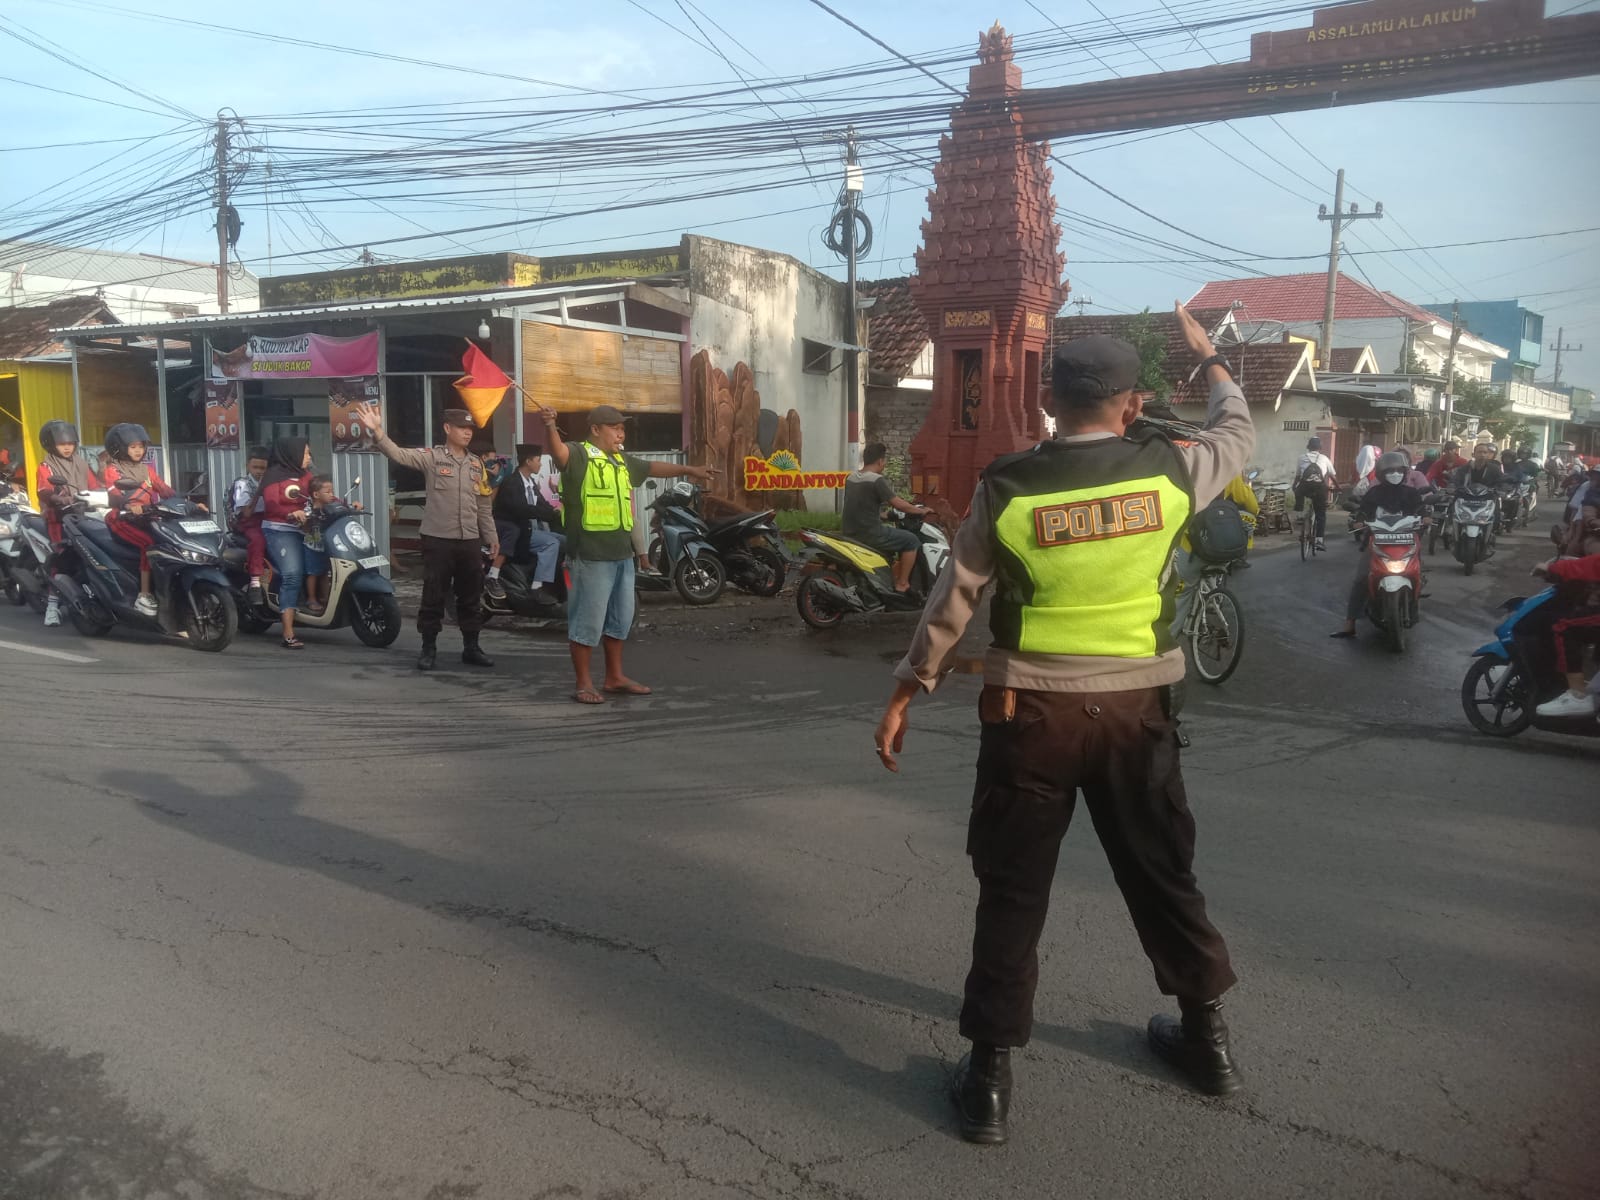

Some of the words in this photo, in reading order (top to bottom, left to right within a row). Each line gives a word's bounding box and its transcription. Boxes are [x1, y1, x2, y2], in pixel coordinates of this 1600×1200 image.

[1307, 18, 1394, 42] ASSALAMU
[1398, 7, 1477, 30] ALAIKUM
[284, 360, 312, 372] BAKAR
[746, 473, 848, 489] PANDANTOY
[1041, 495, 1159, 542] POLISI
